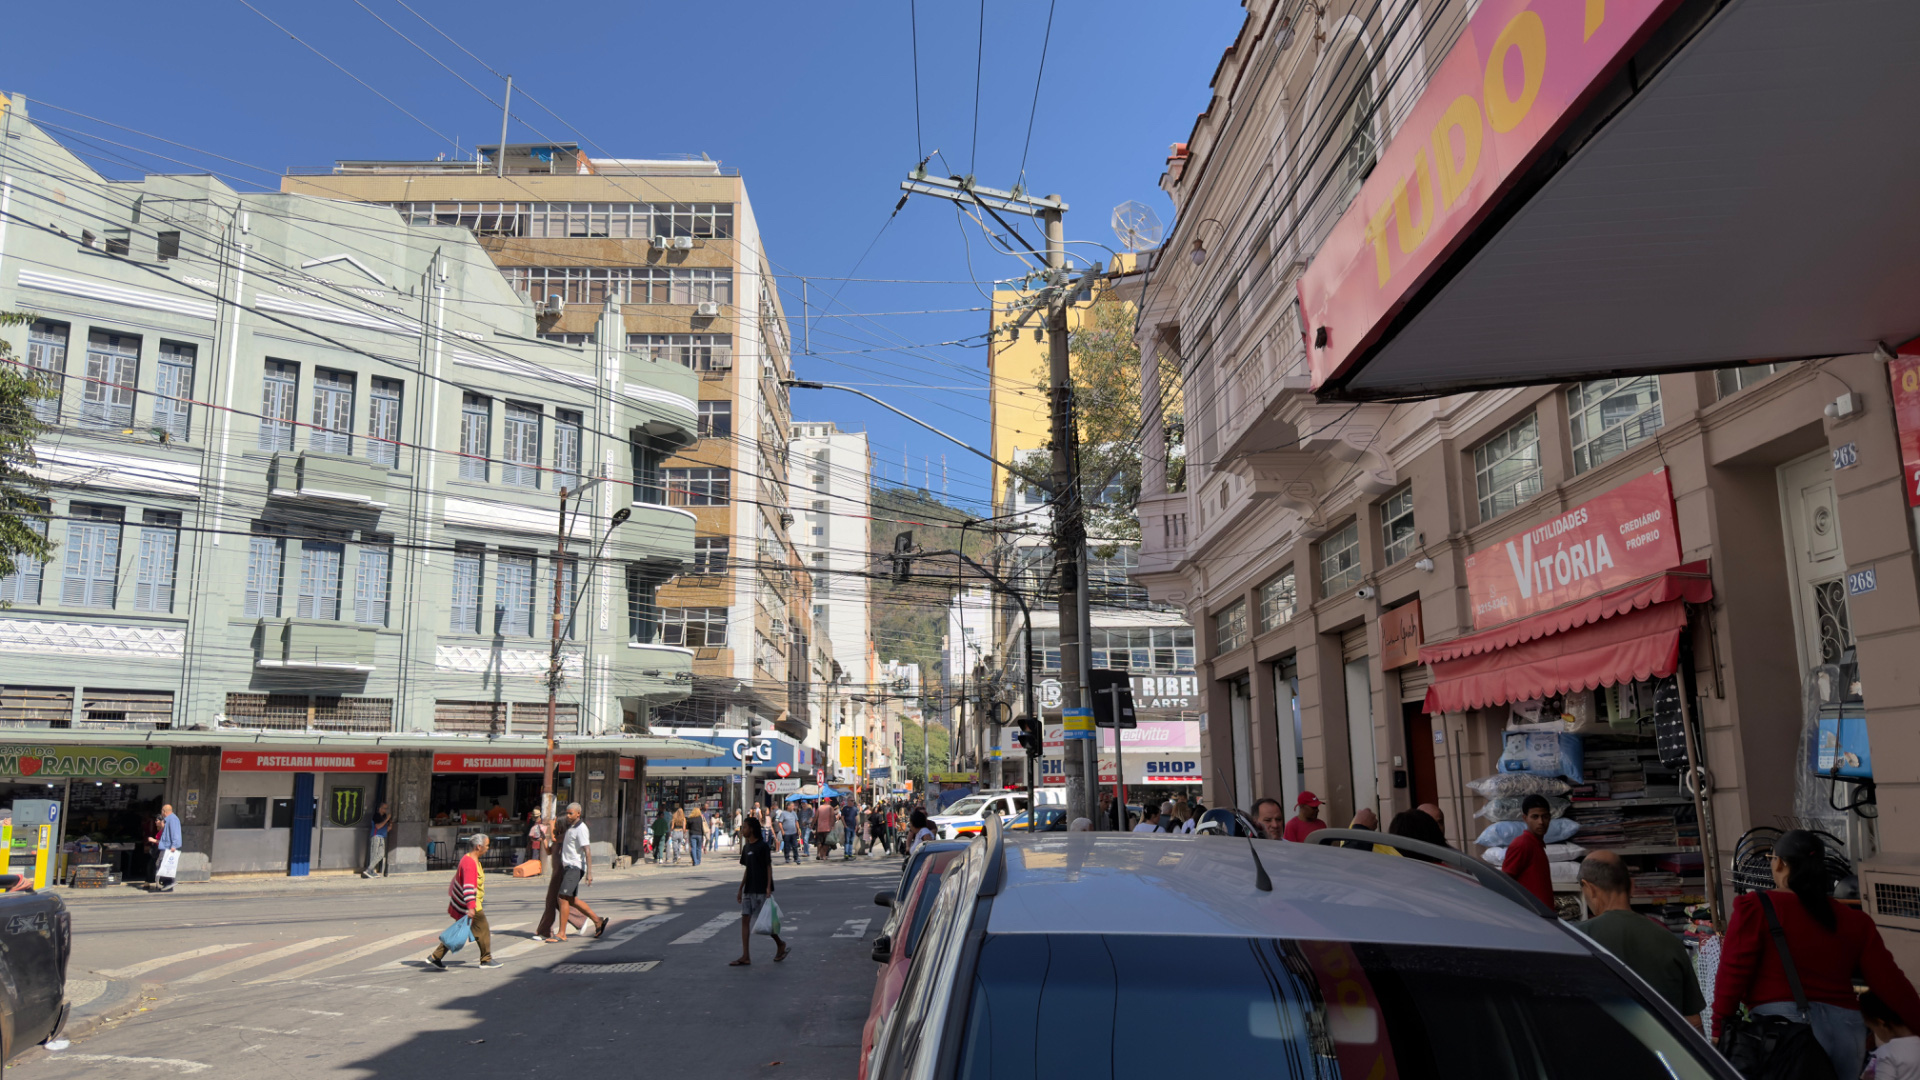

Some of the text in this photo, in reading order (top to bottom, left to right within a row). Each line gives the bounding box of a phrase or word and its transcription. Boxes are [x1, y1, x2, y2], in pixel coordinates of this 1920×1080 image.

[1364, 10, 1547, 290] TUDO
[1833, 441, 1857, 470] 268
[1532, 508, 1588, 545] UTILIDADES
[1620, 510, 1661, 535] CREDIÁRIO
[1626, 529, 1660, 551] PRÓPRIO
[1505, 533, 1614, 599] VITÓRIA
[1850, 570, 1874, 593] 268
[1151, 698, 1189, 708] ARTS
[0, 746, 56, 756] CASA DO
[257, 756, 355, 768] PASTELARIA MUNDIAL
[463, 758, 544, 768] PASTELARIA MUNDIA
[1146, 761, 1196, 773] SHOP
[50, 806, 56, 819] P
